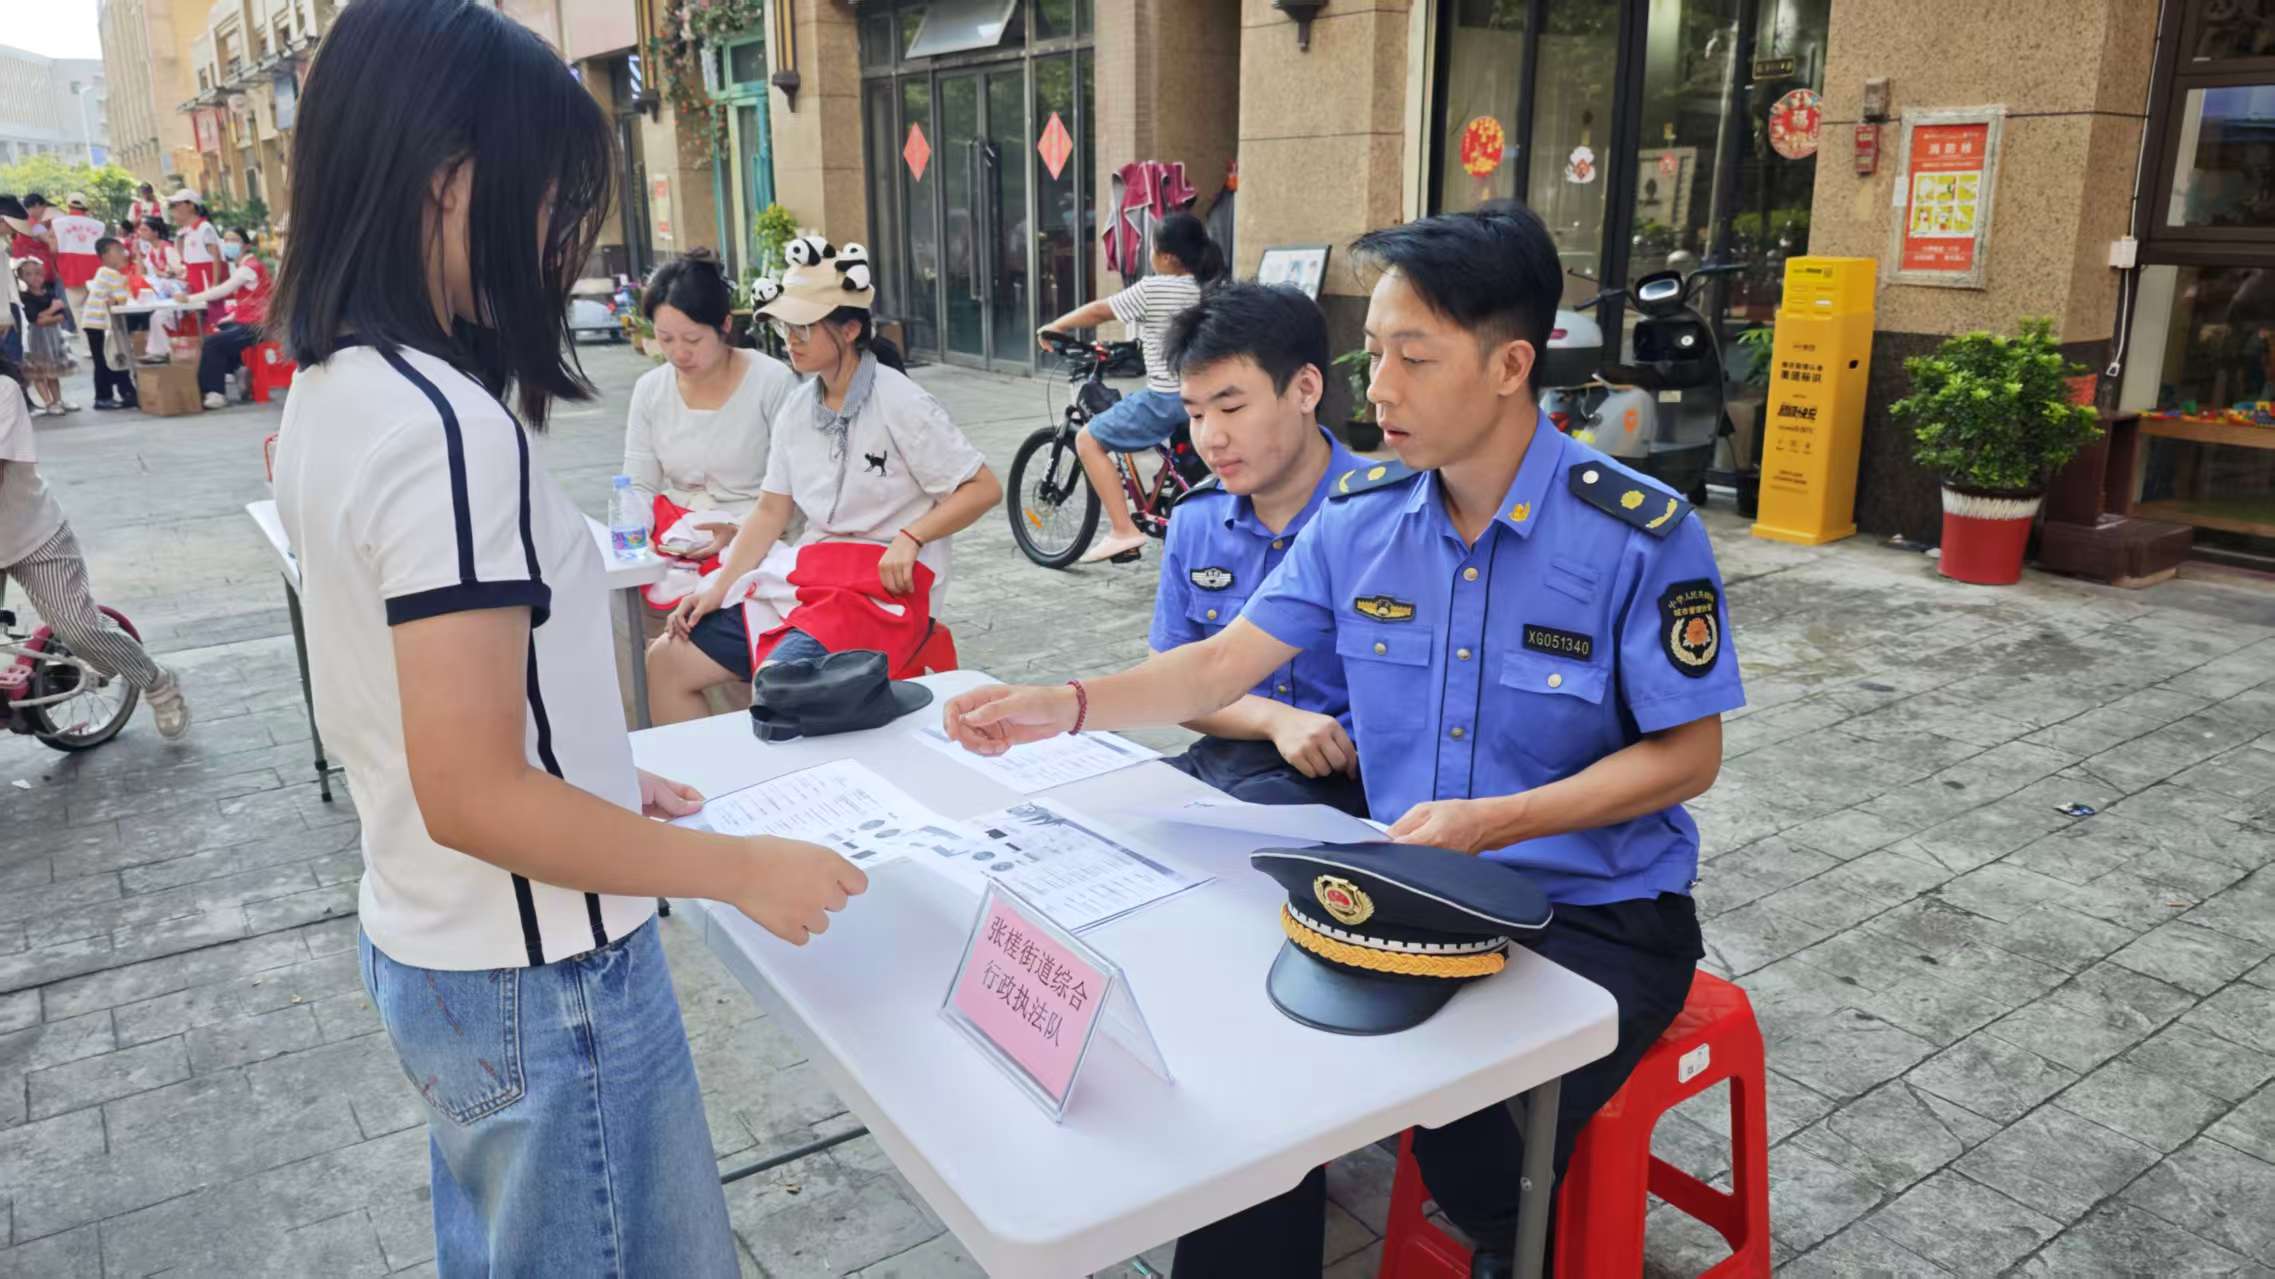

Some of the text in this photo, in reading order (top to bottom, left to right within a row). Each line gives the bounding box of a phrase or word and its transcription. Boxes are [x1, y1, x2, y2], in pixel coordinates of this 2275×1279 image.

[1528, 629, 1589, 655] XG051340
[982, 959, 1064, 1047] 行政执法队
[987, 916, 1088, 1012] 张槎街道综合
